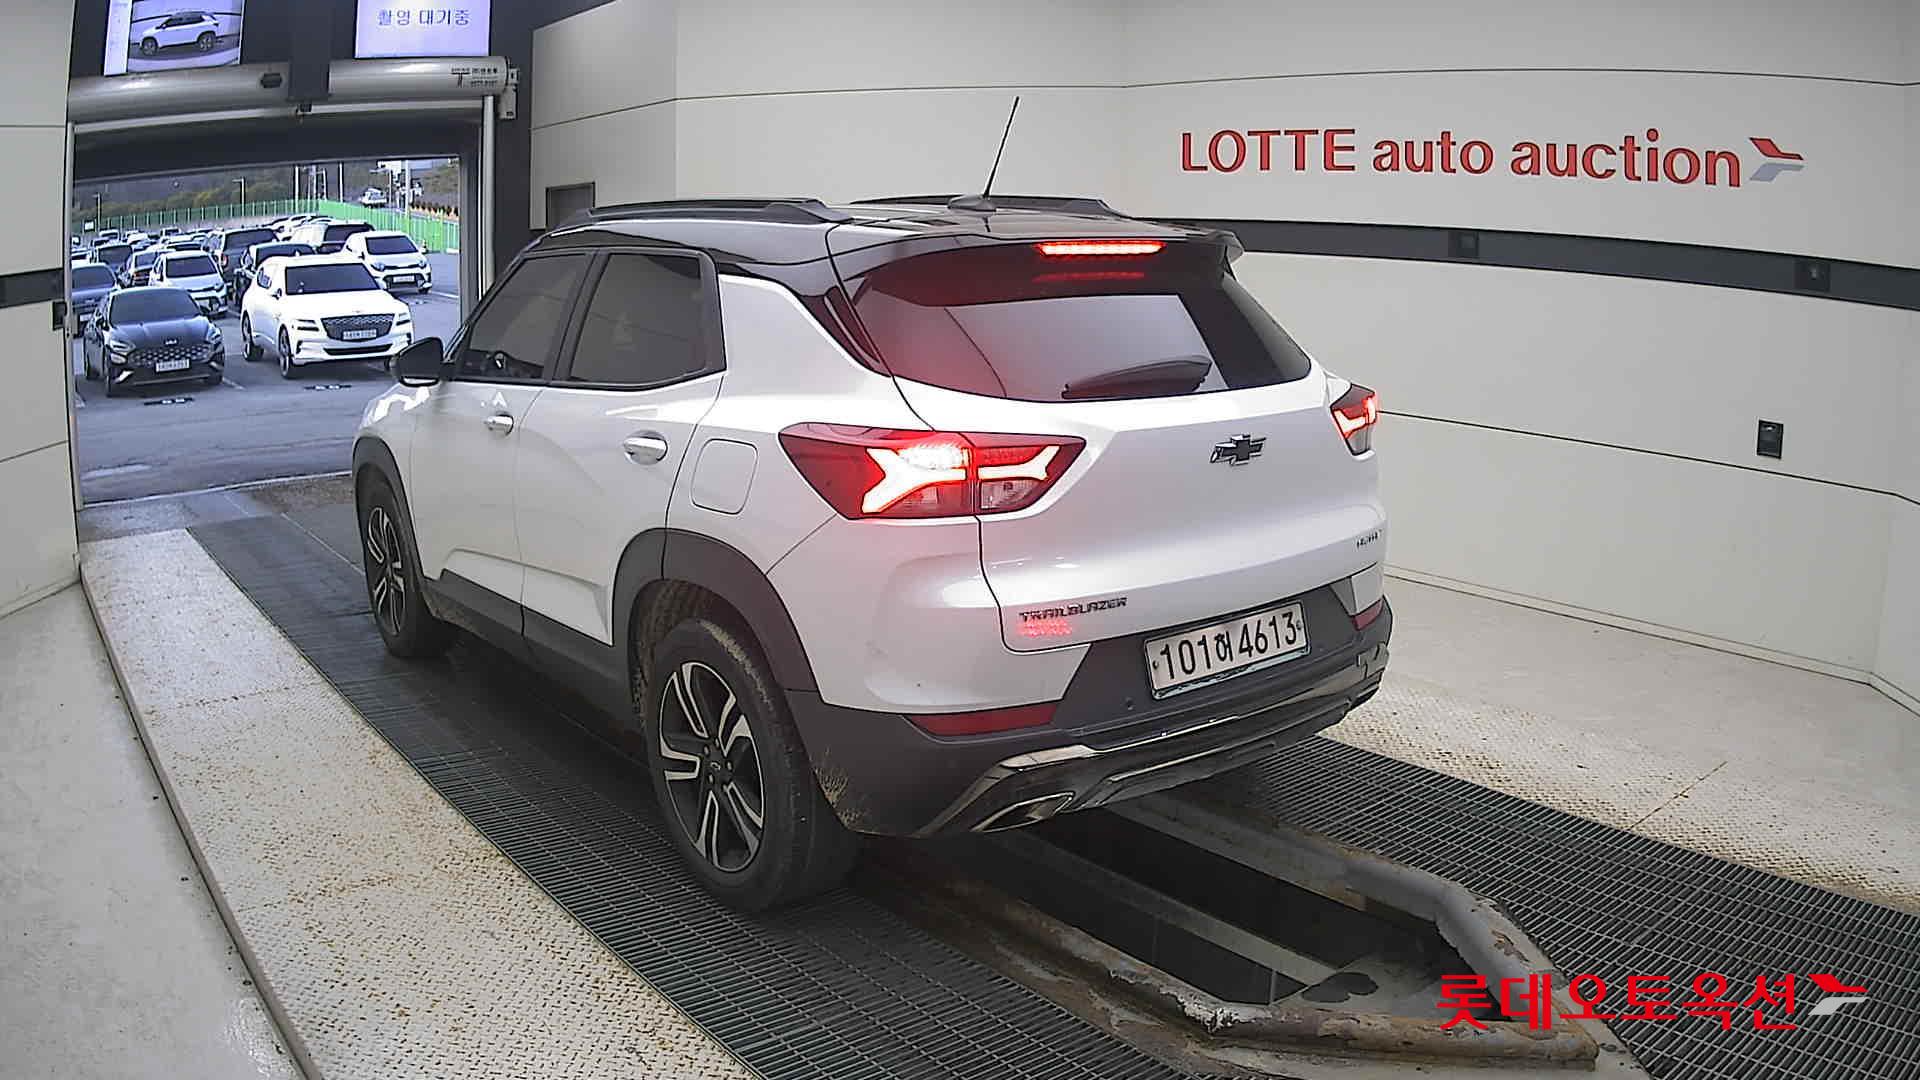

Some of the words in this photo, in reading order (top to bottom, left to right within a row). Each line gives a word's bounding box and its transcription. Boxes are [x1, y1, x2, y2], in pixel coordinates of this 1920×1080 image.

[419, 9, 469, 25] 대기중
[1181, 128, 1356, 173] LOTTE
[1372, 130, 1495, 175] auto
[1509, 127, 1741, 188] auction
[1018, 596, 1128, 622] TRAILBLAZER
